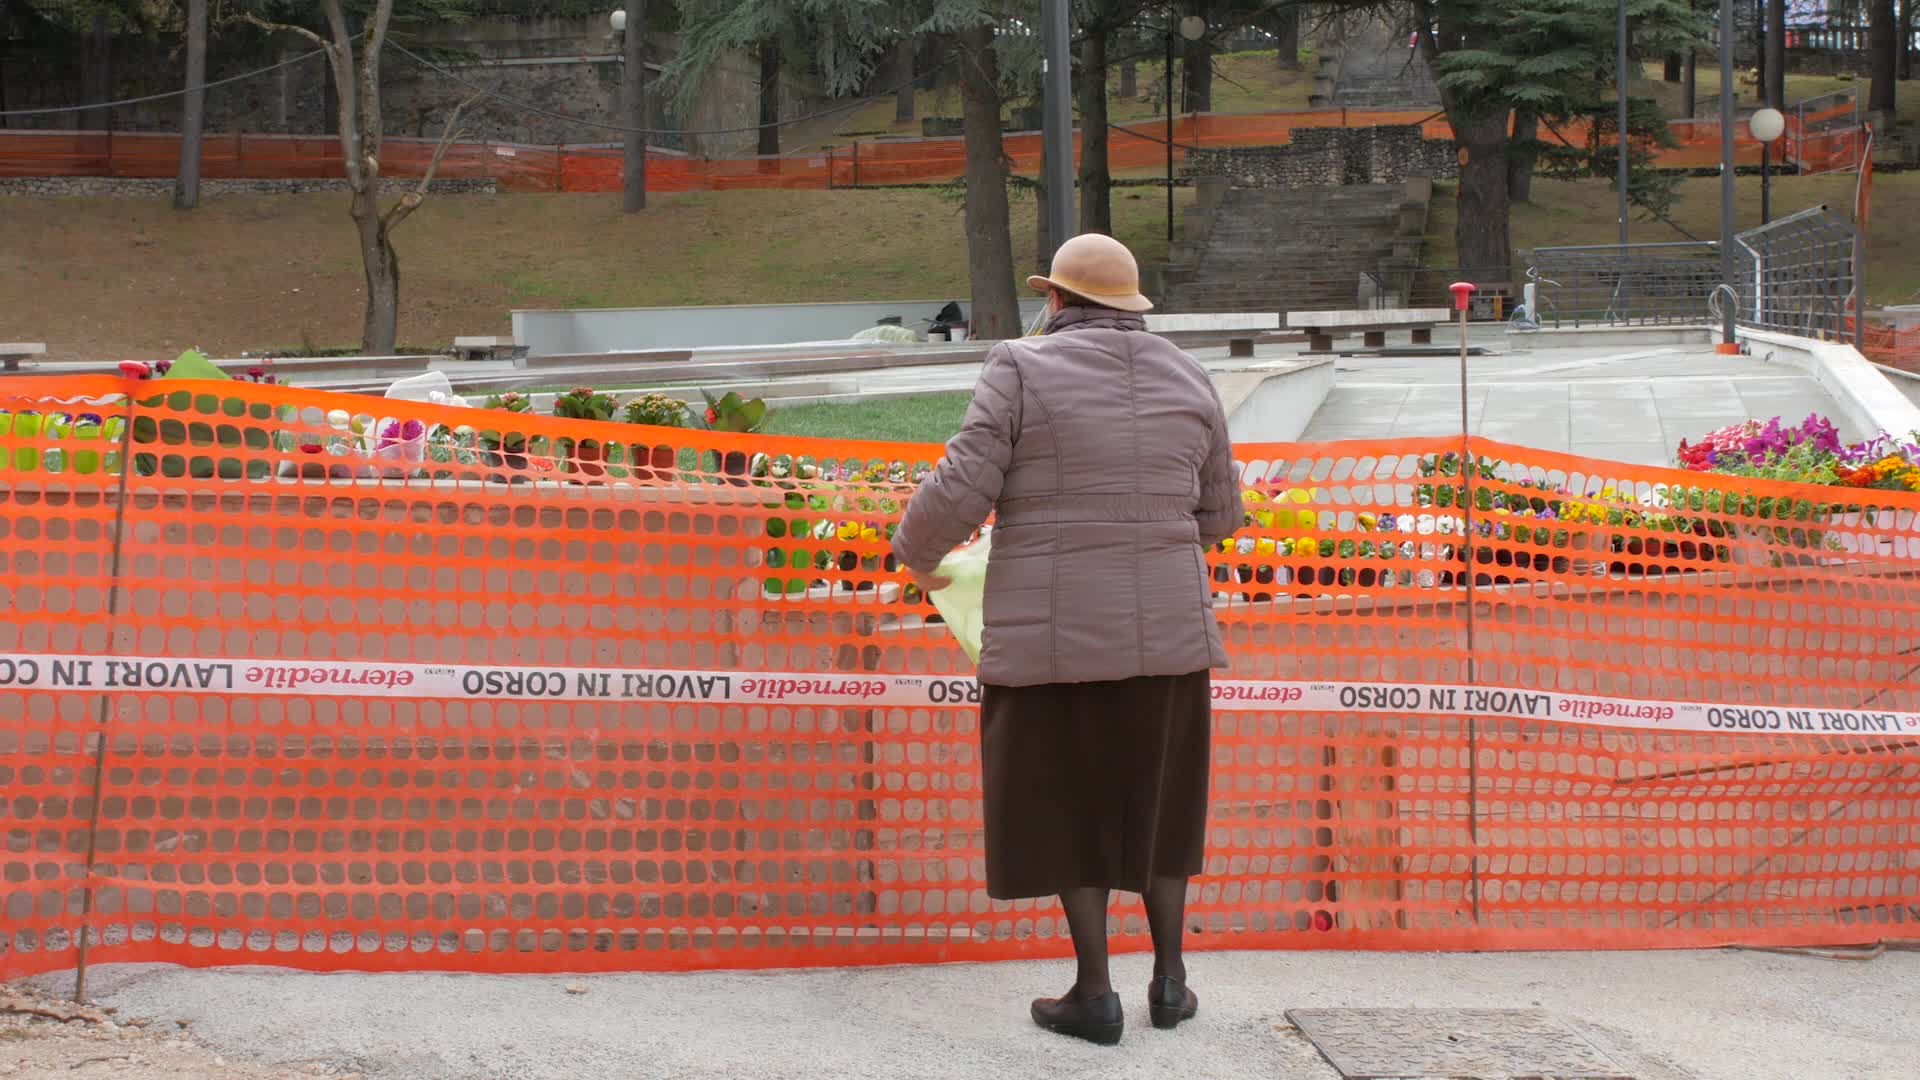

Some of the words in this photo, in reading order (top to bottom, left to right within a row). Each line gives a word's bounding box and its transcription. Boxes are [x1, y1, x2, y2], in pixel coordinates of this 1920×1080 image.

[52, 659, 93, 686] IN
[104, 661, 233, 689] LAVORI
[244, 666, 415, 689] eternedile
[462, 670, 567, 696] CORSO
[577, 672, 612, 697] IN
[621, 673, 731, 699] LAVORI
[740, 678, 887, 699] eternedile
[1339, 686, 1421, 709] CORSO
[1429, 688, 1457, 710] IN
[1463, 689, 1551, 716] LAVORI
[1558, 699, 1674, 721] eternedile
[1707, 707, 1780, 729] CORSO
[1786, 711, 1816, 730] IN
[1817, 711, 1902, 731] LAVORI
